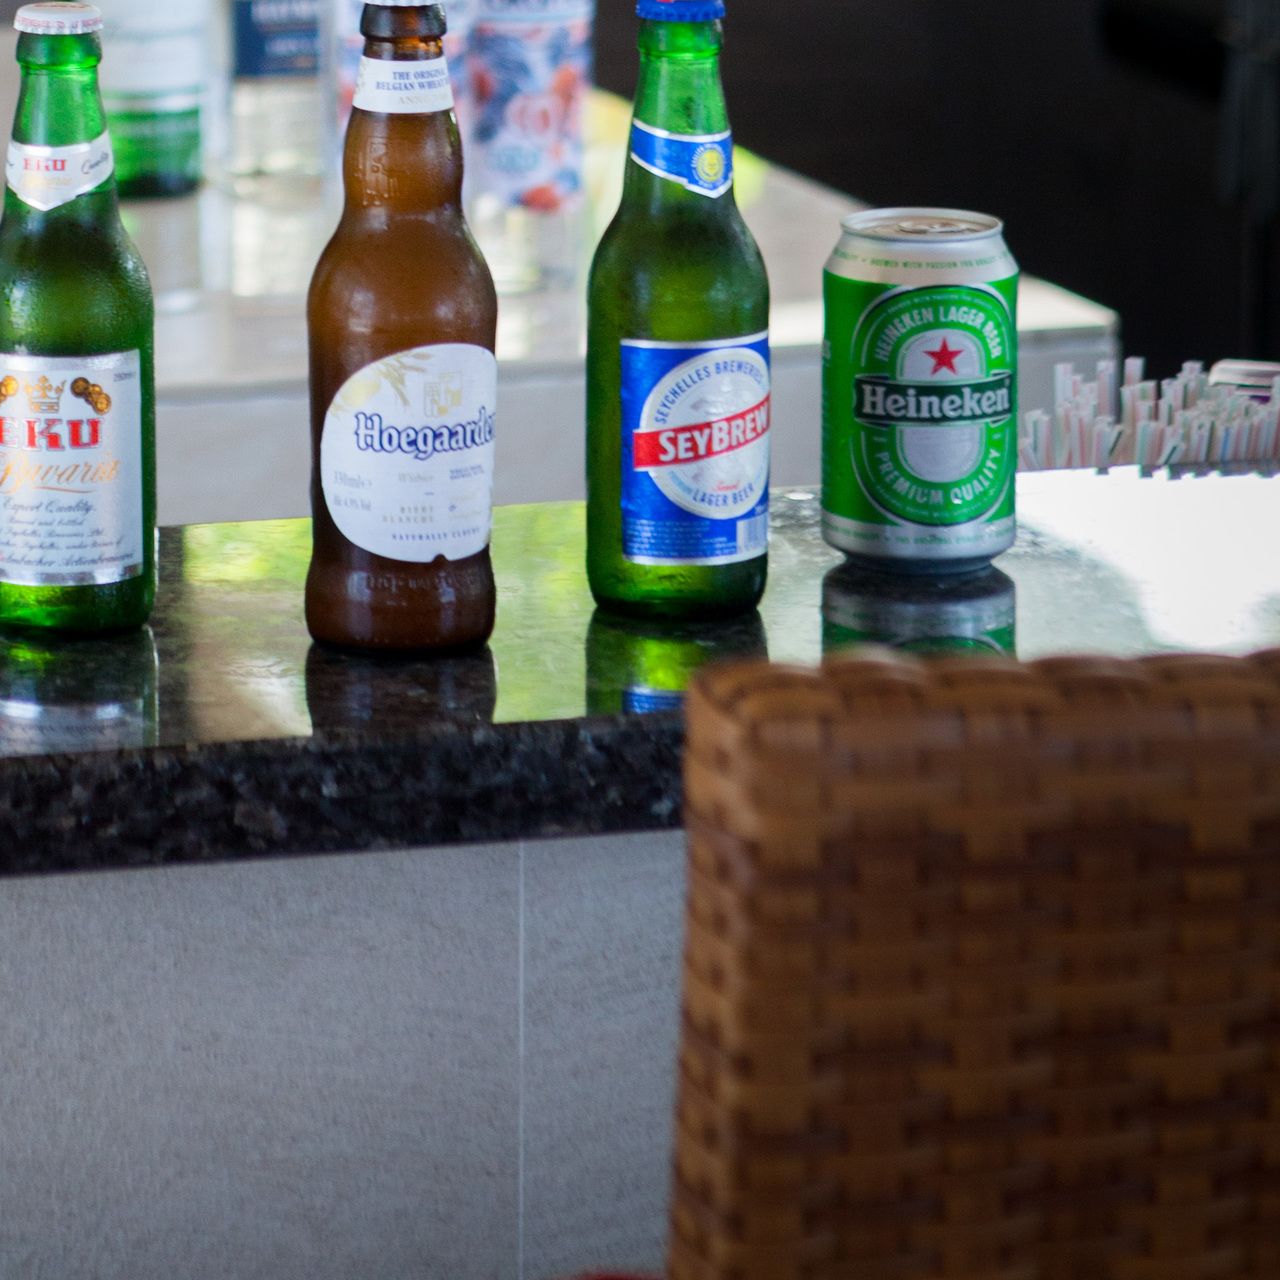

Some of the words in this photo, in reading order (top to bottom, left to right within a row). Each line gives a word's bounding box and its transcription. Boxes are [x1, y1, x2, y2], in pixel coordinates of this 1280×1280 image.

[392, 70, 411, 81] THE
[376, 81, 416, 92] BELGIAN
[23, 158, 68, 172] EKU
[874, 307, 935, 362] HEINEKEN
[939, 306, 986, 327] LAGER
[982, 321, 1003, 359] BEER
[655, 365, 713, 425] SEYCHELLES
[861, 383, 1010, 419] Heineken
[874, 451, 945, 505] PREMIUM
[950, 448, 1001, 505] QUALITY
[3, 496, 44, 512] Export
[692, 489, 730, 507] LAGER
[733, 483, 755, 505] BEER
[392, 531, 448, 541] NATURALLY
